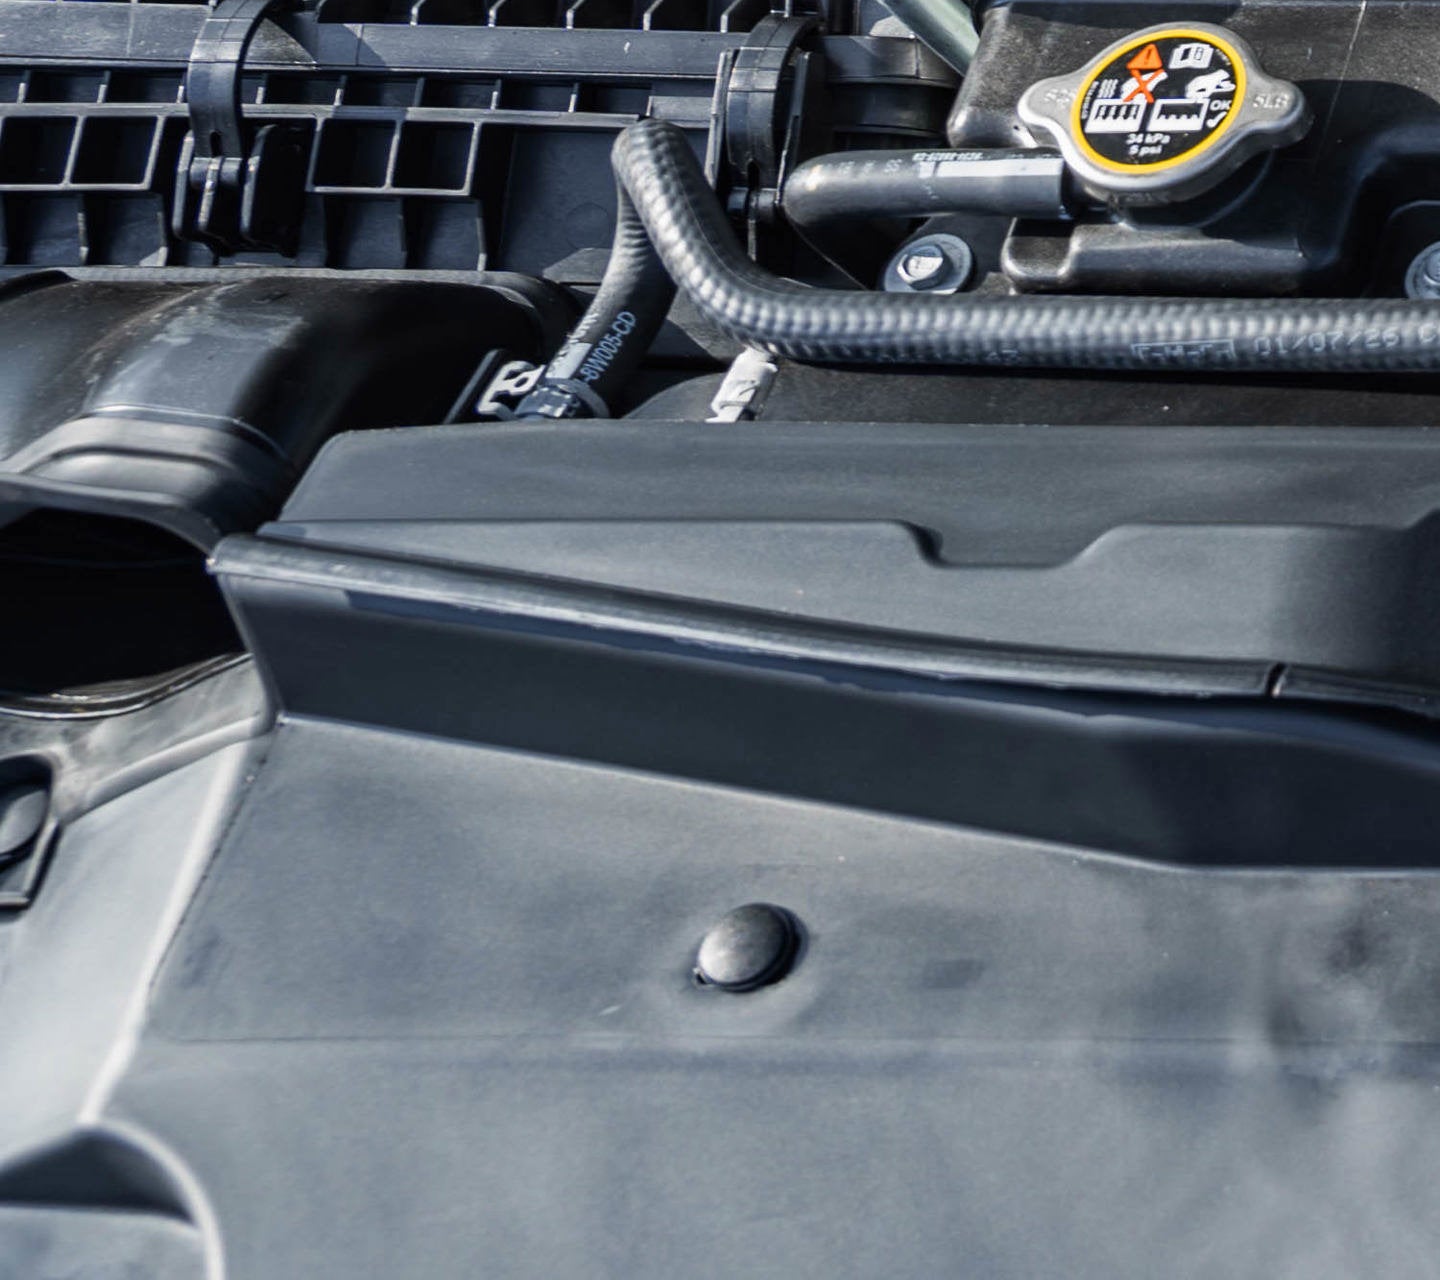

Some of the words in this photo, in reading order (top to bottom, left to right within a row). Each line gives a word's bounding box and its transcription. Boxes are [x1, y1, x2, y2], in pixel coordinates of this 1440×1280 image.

[1211, 100, 1231, 110] OK
[1147, 133, 1171, 145] kPa
[1139, 145, 1162, 156] psi
